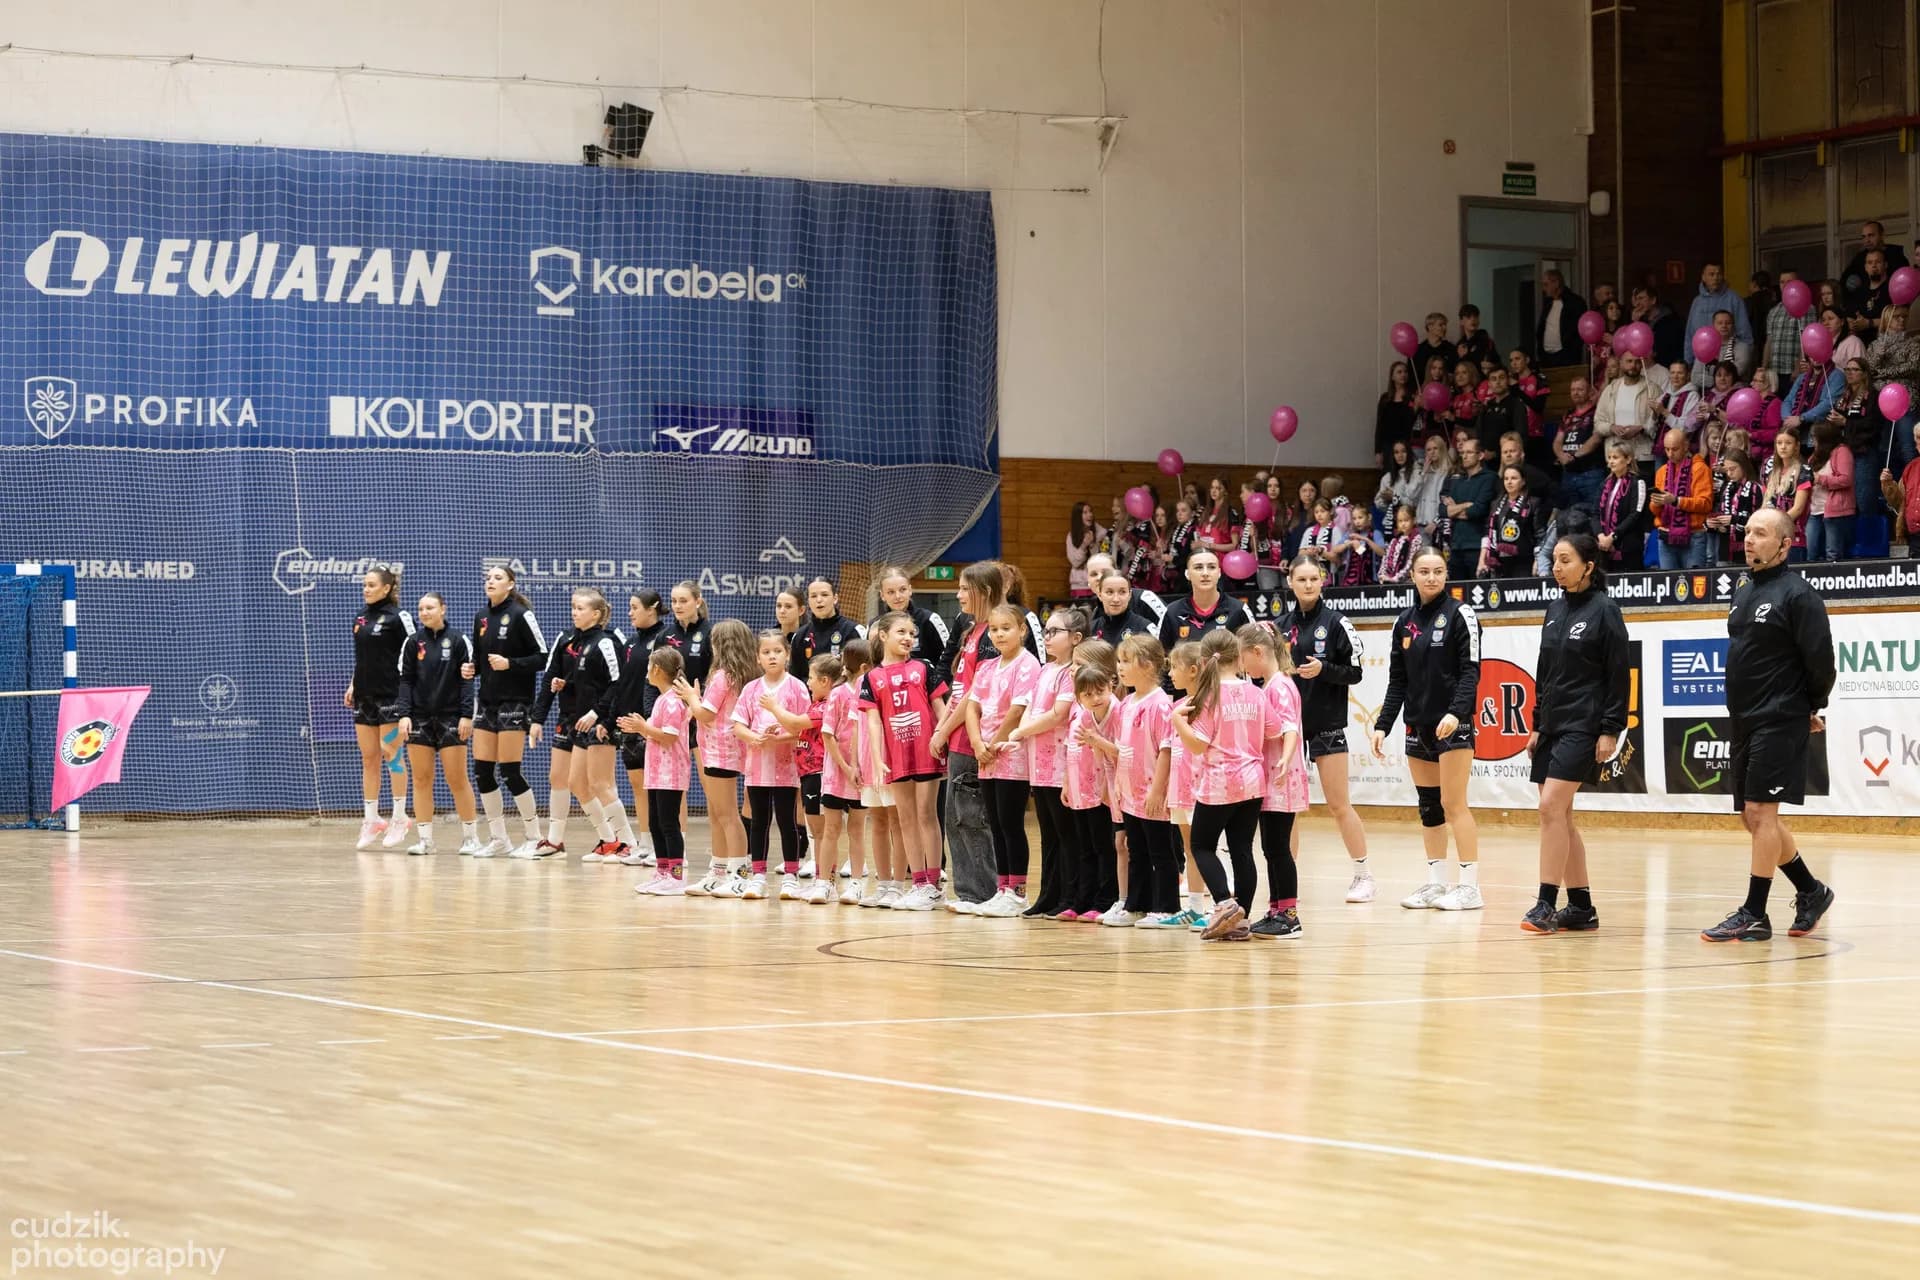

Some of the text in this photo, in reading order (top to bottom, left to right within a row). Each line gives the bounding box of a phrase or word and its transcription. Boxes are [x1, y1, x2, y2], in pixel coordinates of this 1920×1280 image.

[113, 231, 452, 307] LEWIATAN
[593, 258, 782, 303] karabela
[85, 394, 259, 428] PROFIKA
[357, 396, 597, 444] KOLPORTER
[892, 690, 908, 707] 57
[1500, 682, 1530, 736] R
